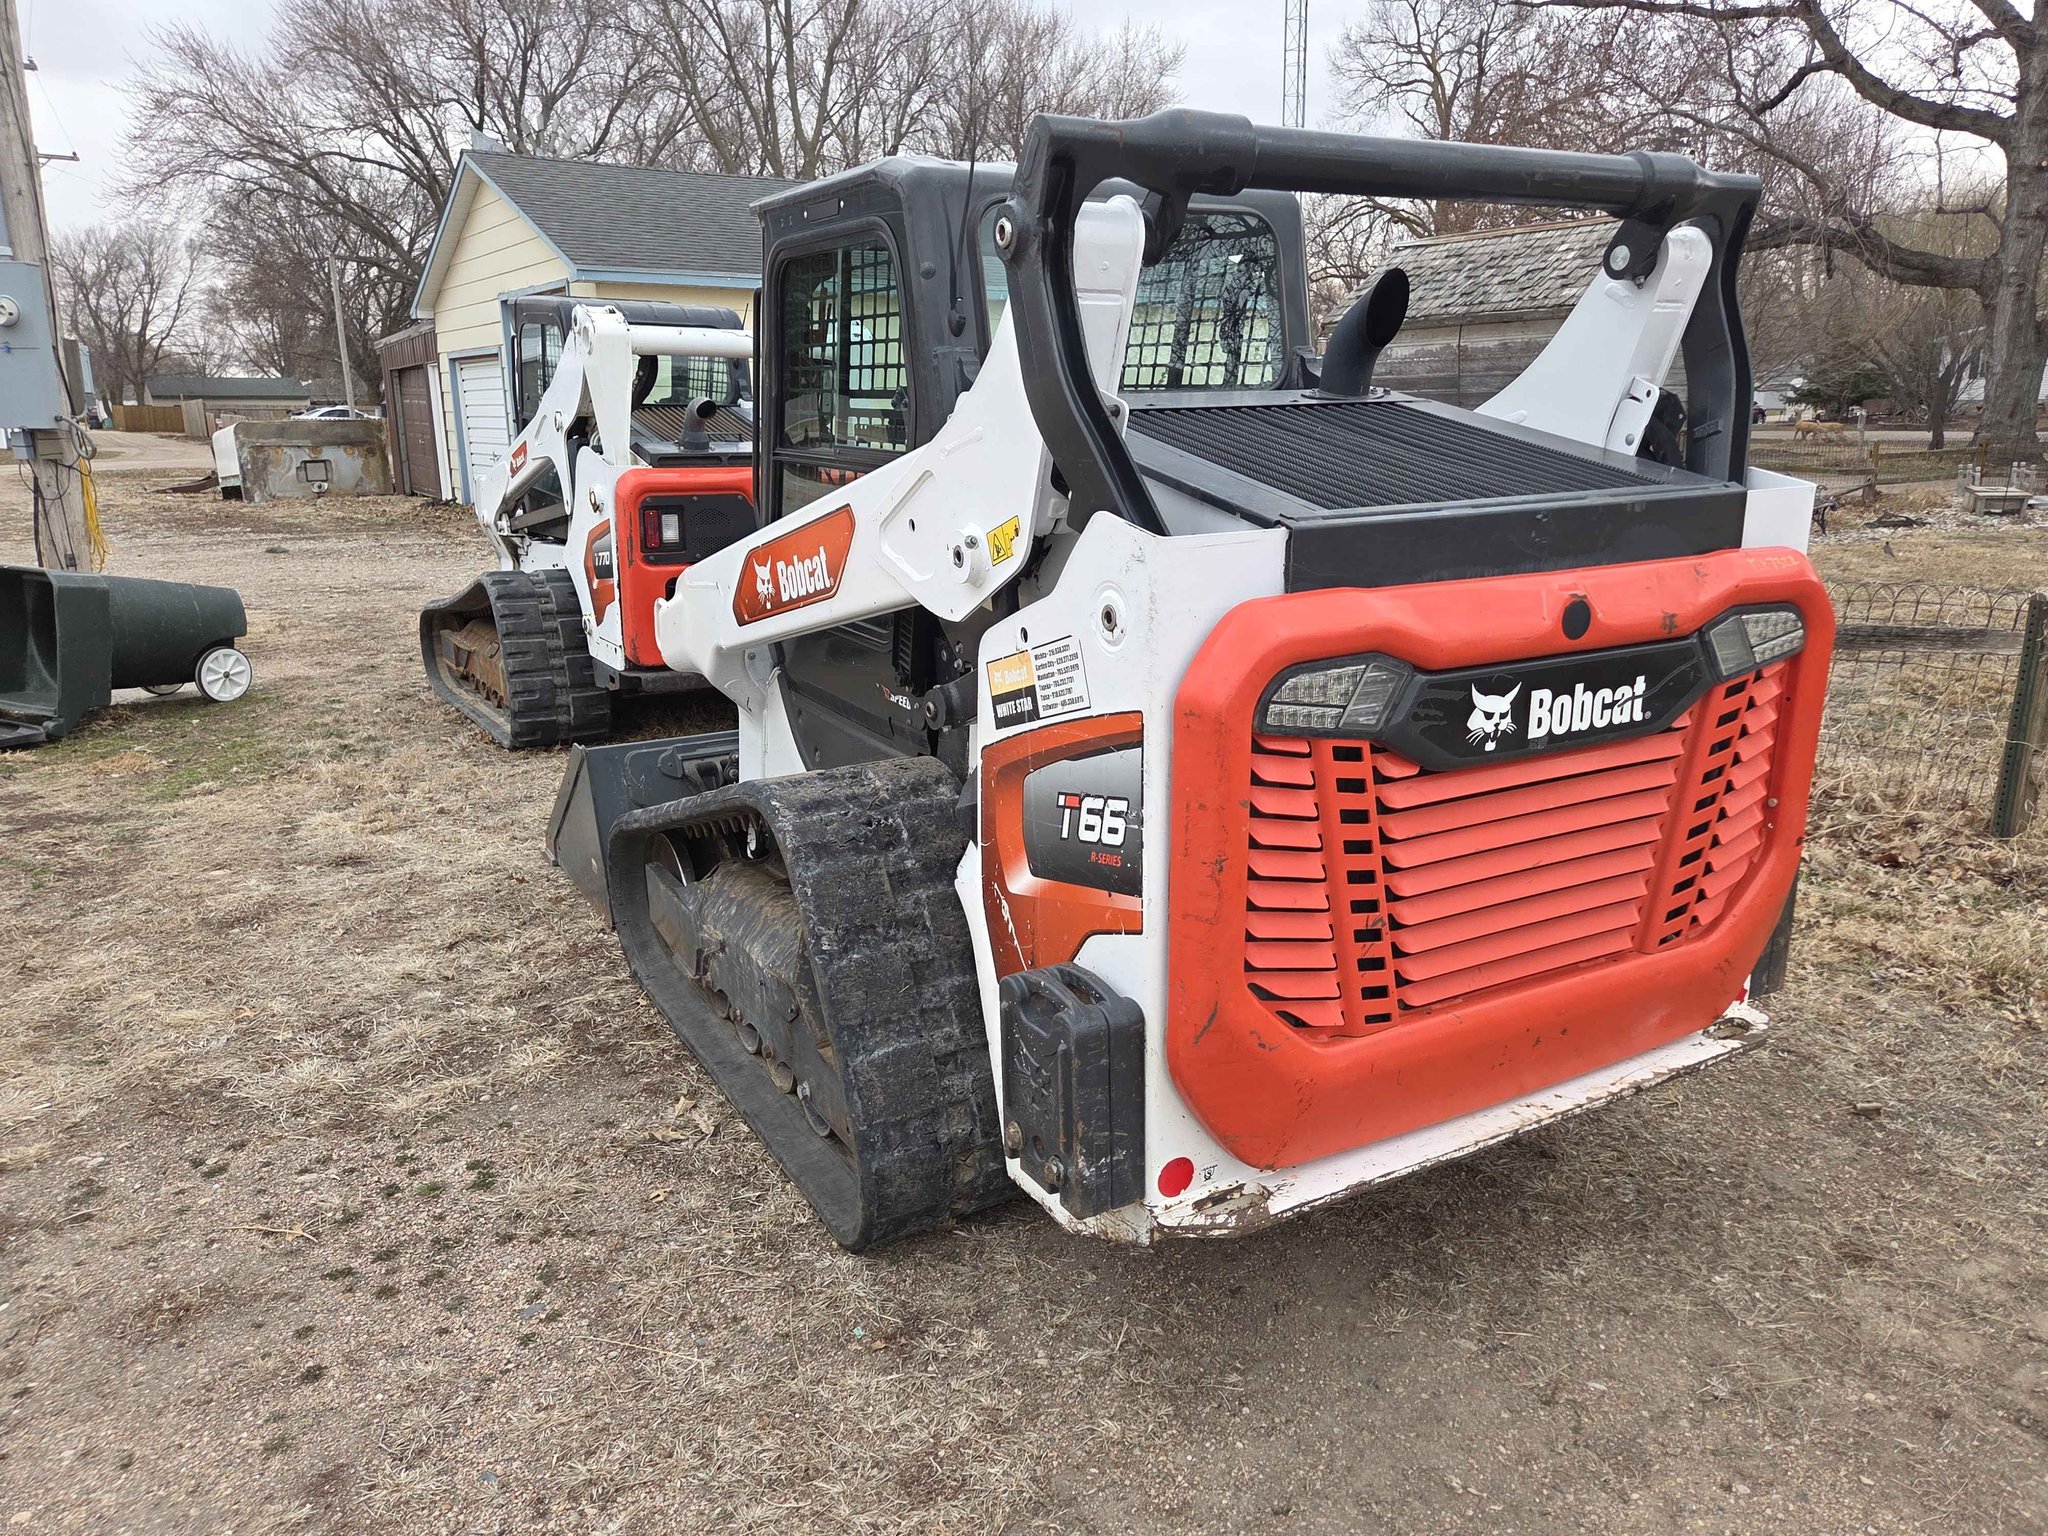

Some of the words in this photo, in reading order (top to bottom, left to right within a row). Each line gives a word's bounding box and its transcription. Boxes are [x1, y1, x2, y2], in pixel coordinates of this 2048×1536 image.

[776, 545, 830, 602] Bobcat
[1034, 652, 1047, 661] Wichita
[1035, 662, 1048, 671] Garden
[1047, 659, 1055, 668] City
[1037, 671, 1055, 681] Manhattan
[1039, 683, 1051, 692] Topeka
[995, 700, 1016, 718] WHITE
[1015, 696, 1033, 713] STAR
[1042, 702, 1058, 712] Stillwater
[1527, 675, 1646, 740] Bobcat
[1057, 793, 1129, 847] T66
[1090, 851, 1122, 867] R-SERIES
